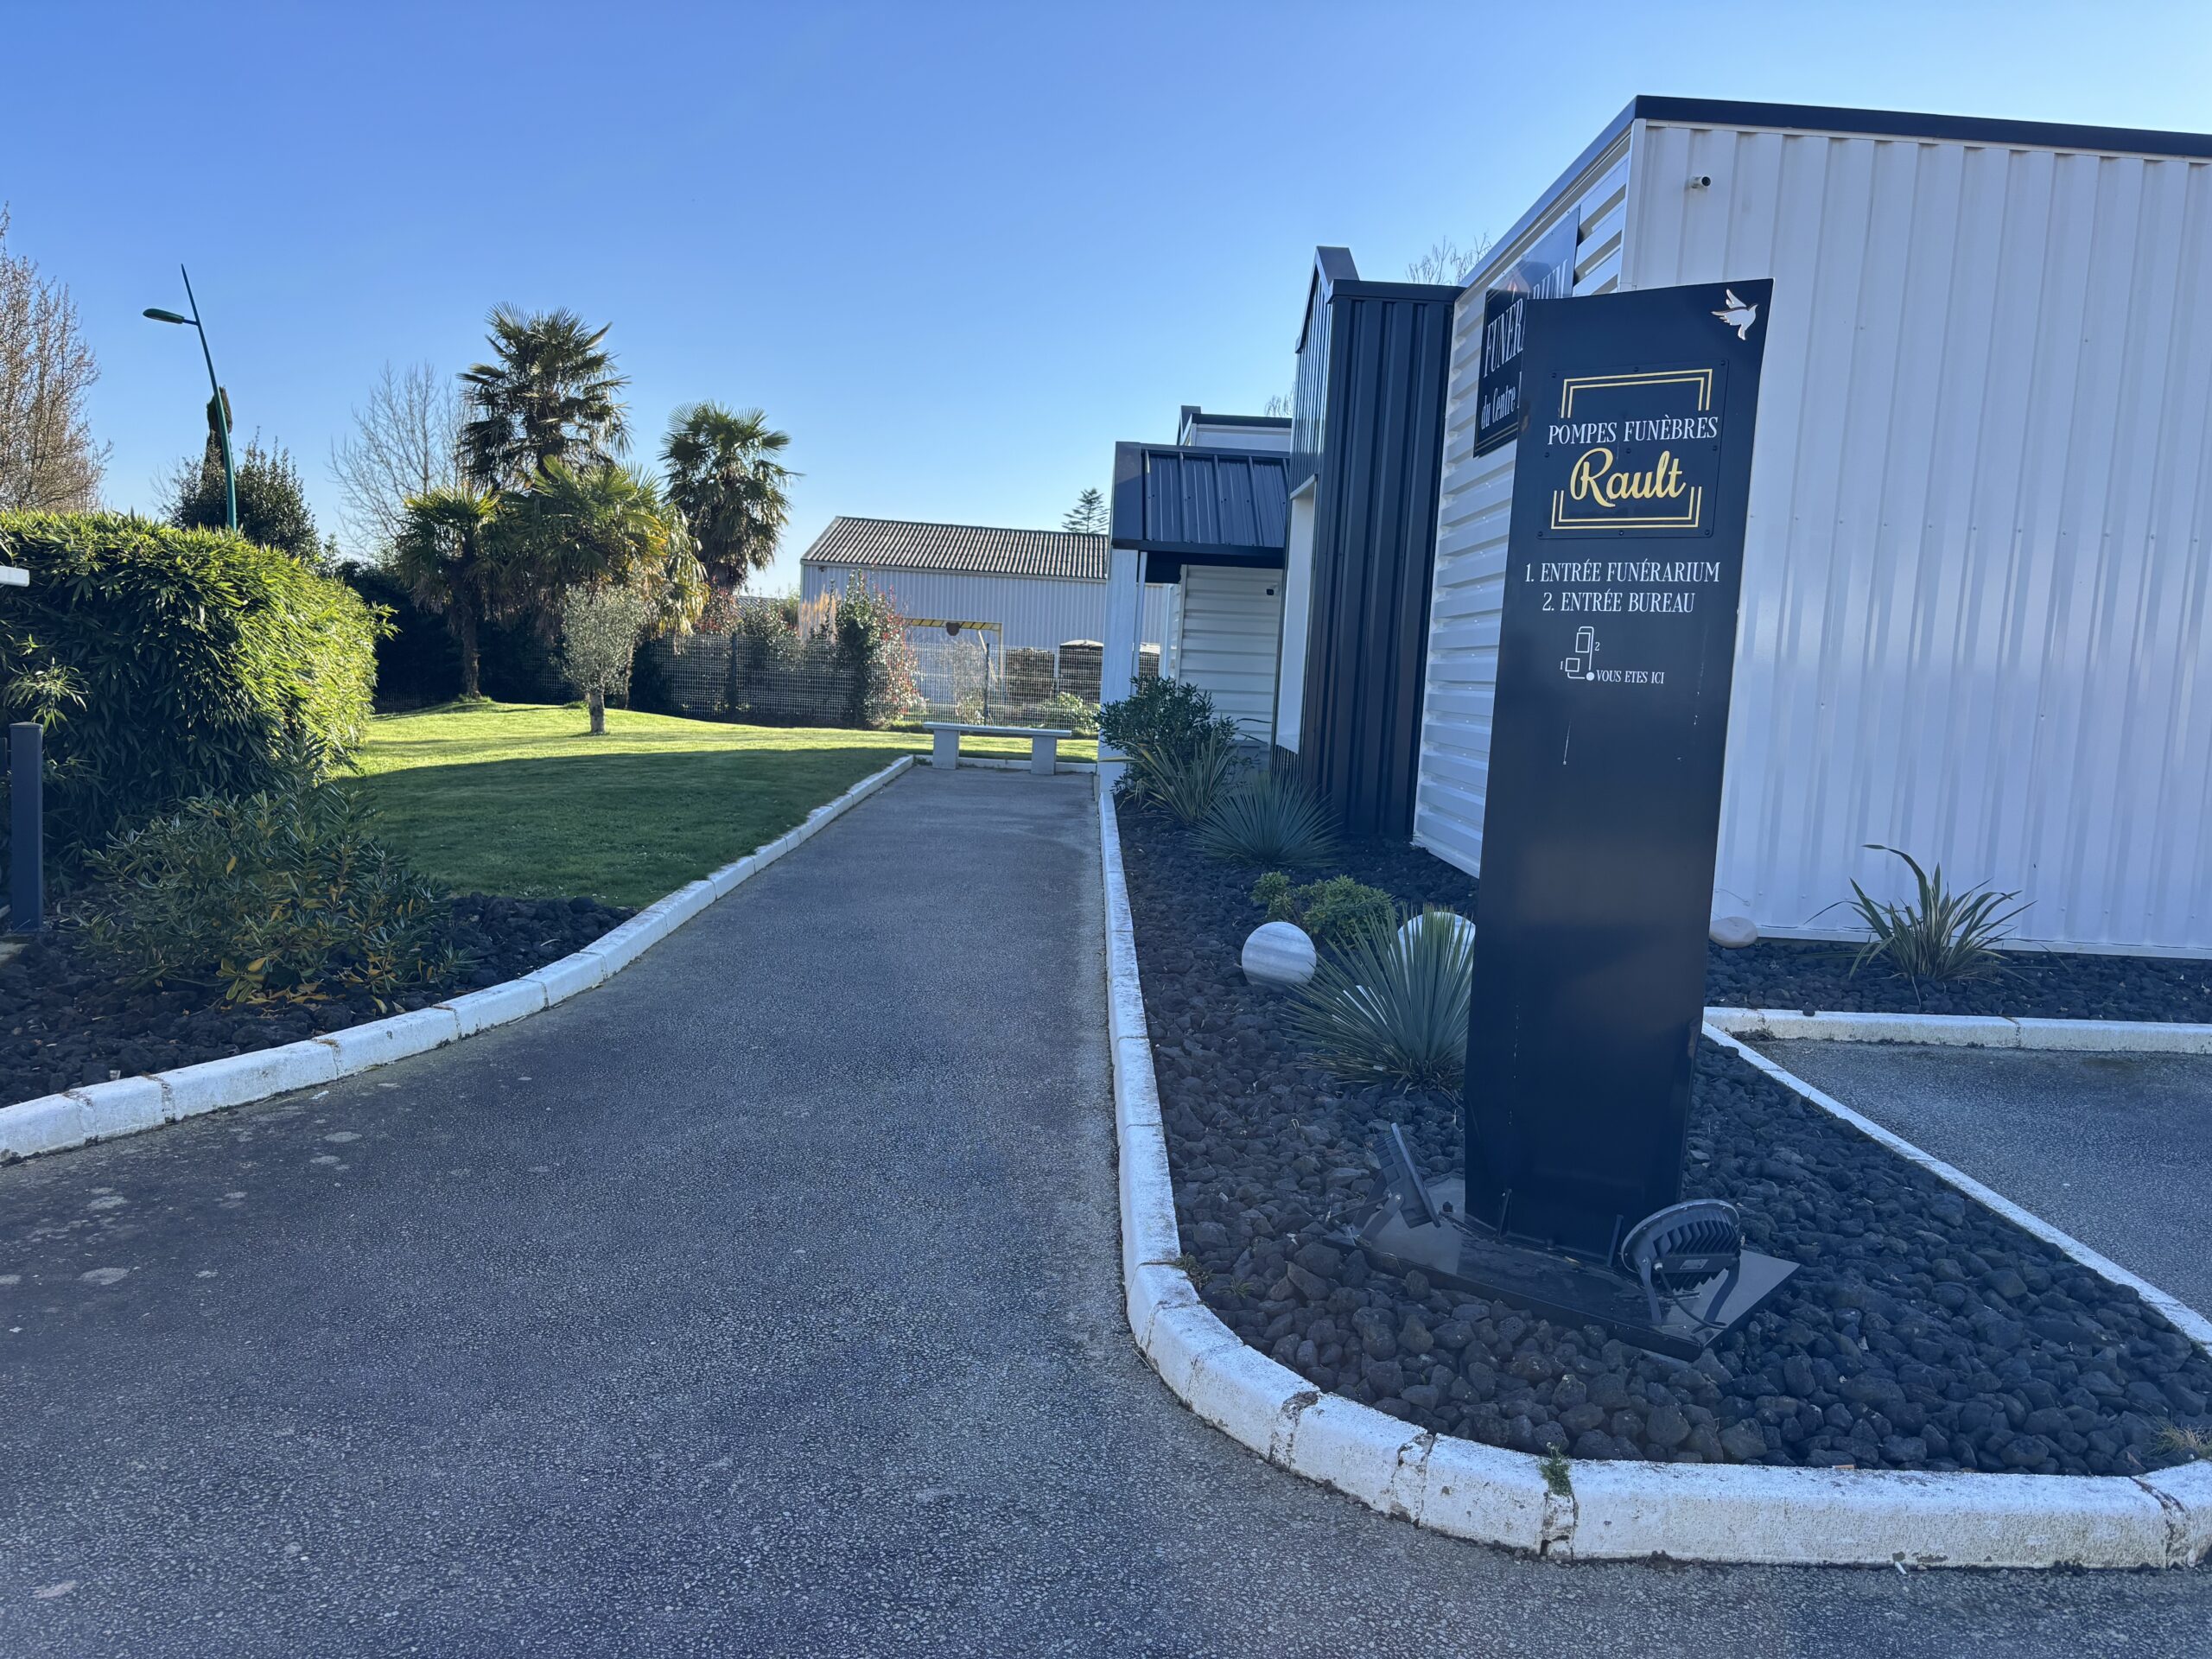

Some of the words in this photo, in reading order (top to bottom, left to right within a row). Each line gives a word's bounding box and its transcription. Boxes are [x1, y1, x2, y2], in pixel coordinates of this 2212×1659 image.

[1484, 259, 1567, 378] FUNÉRM
[1481, 394, 1491, 430] du
[1492, 385, 1516, 423] Centre
[1548, 422, 1618, 445] POMPES
[1624, 415, 1719, 442] FUNÈBRES
[1570, 448, 1687, 508] Rault
[1525, 563, 1535, 582] 1.
[1540, 558, 1602, 582] ENTRÉE
[1606, 558, 1721, 582] FUNÉRARIUM
[1542, 592, 1554, 611] 2.
[1560, 588, 1623, 612] ENTRÉE
[1628, 593, 1696, 613] BUREAU
[1594, 641, 1600, 652] 2
[1560, 660, 1564, 671] 1
[1596, 670, 1622, 683] VOUS
[1624, 671, 1649, 683] ETES
[1651, 671, 1665, 684] ICI
